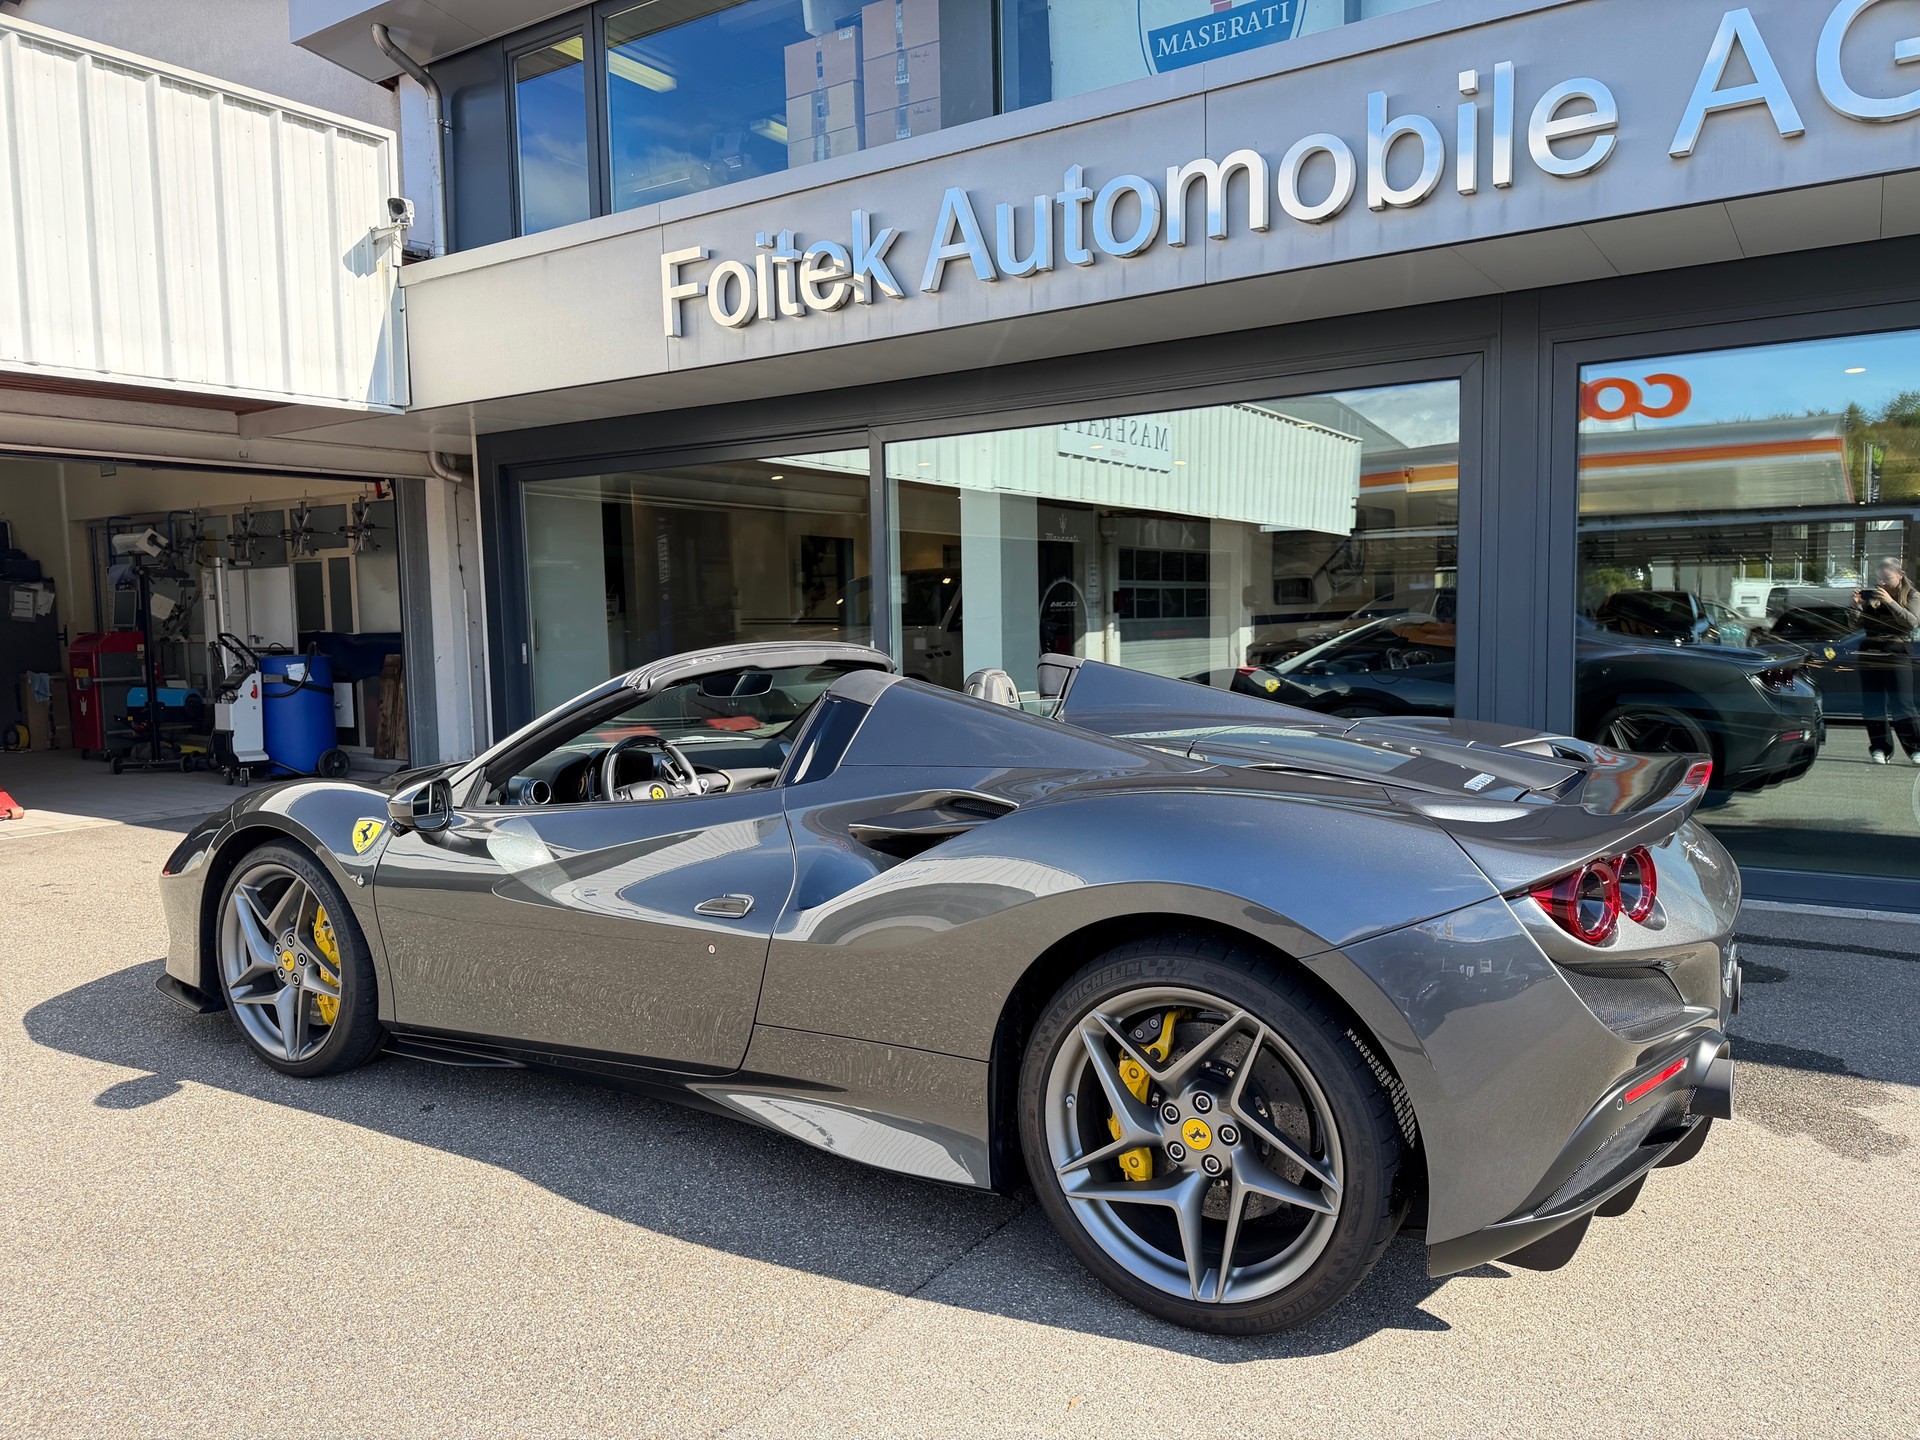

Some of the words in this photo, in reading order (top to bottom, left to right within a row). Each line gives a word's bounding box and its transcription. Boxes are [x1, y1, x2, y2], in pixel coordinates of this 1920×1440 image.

[1156, 1, 1290, 58] MASERATI
[660, 209, 904, 338] Foitek
[919, 60, 1619, 294] Automobile
[1668, 0, 1920, 160] AG
[1066, 962, 1141, 1008] MICHELIN
